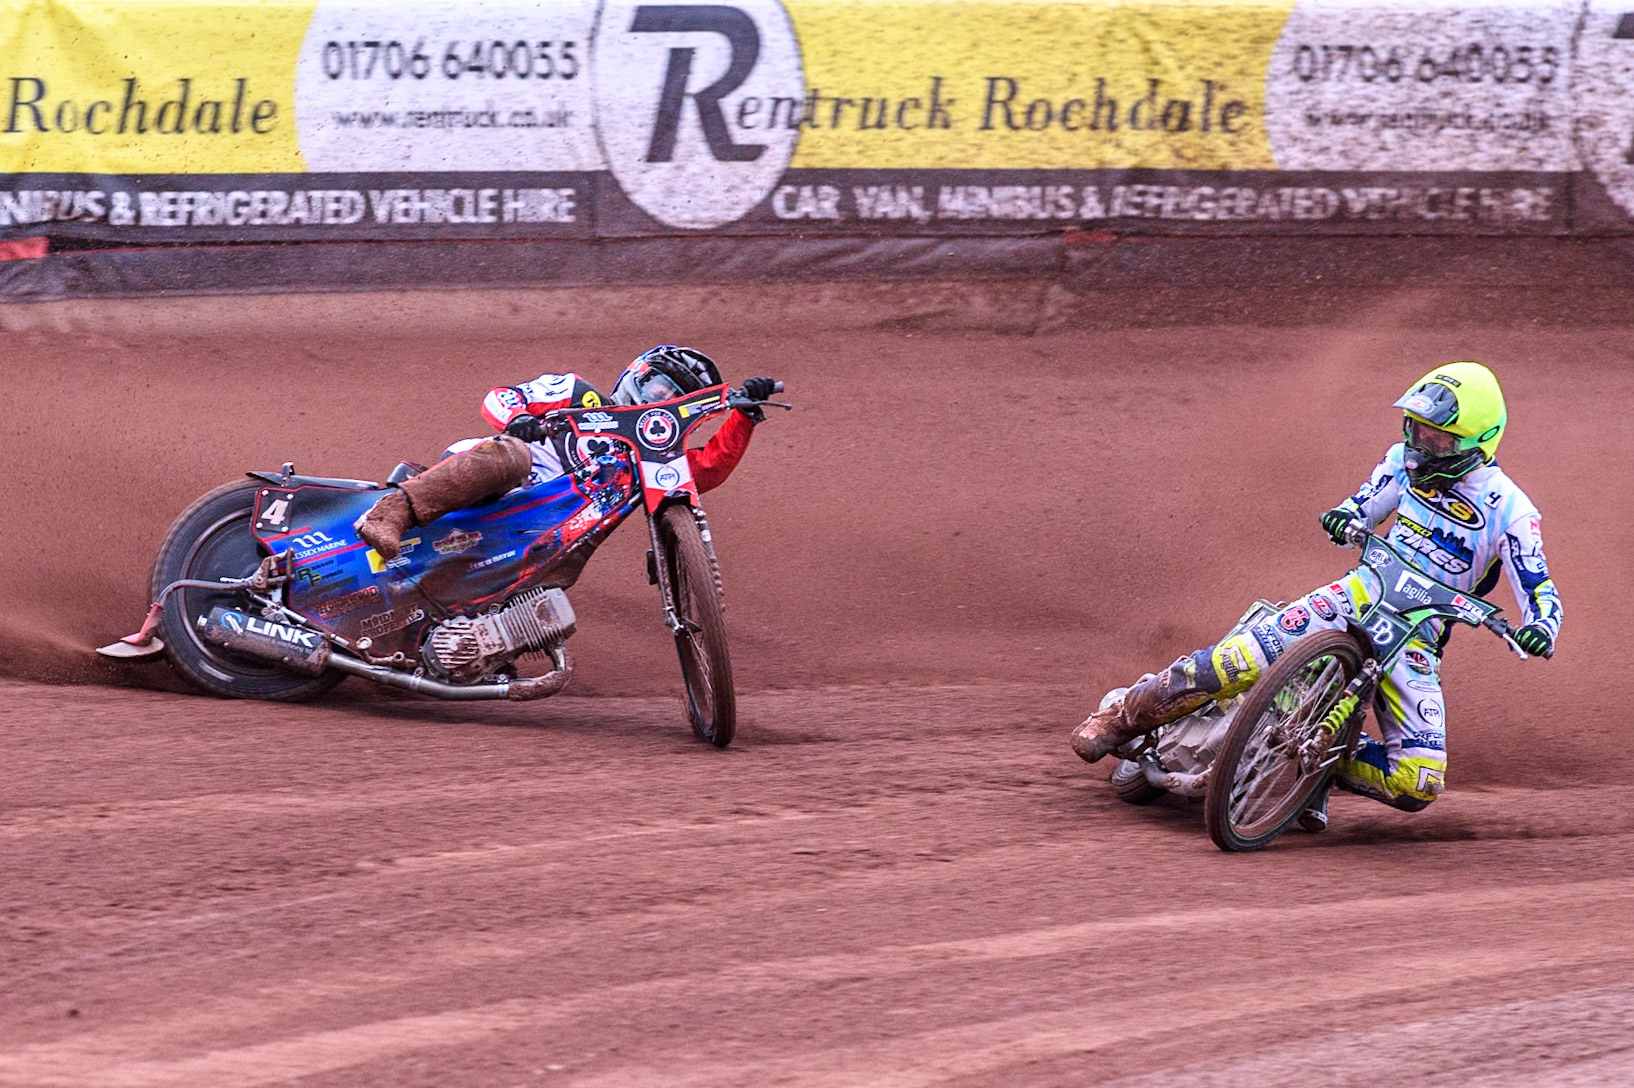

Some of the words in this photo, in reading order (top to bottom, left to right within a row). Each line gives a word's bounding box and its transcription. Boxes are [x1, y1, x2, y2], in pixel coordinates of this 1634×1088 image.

[323, 38, 430, 80] 01706
[442, 37, 579, 80] 640055
[2, 76, 279, 135] Rochdale
[979, 76, 1249, 133] Rochdale
[108, 191, 136, 226] &
[138, 190, 366, 226] REFRIGERATED
[368, 189, 500, 223] VEHICLE
[503, 188, 577, 223] HIRE
[772, 185, 841, 219] CAR
[261, 499, 289, 526] 4
[294, 547, 320, 560] ESSEX
[318, 539, 348, 554] MARINE
[1402, 583, 1433, 605] agilia
[246, 616, 317, 648] LINK
